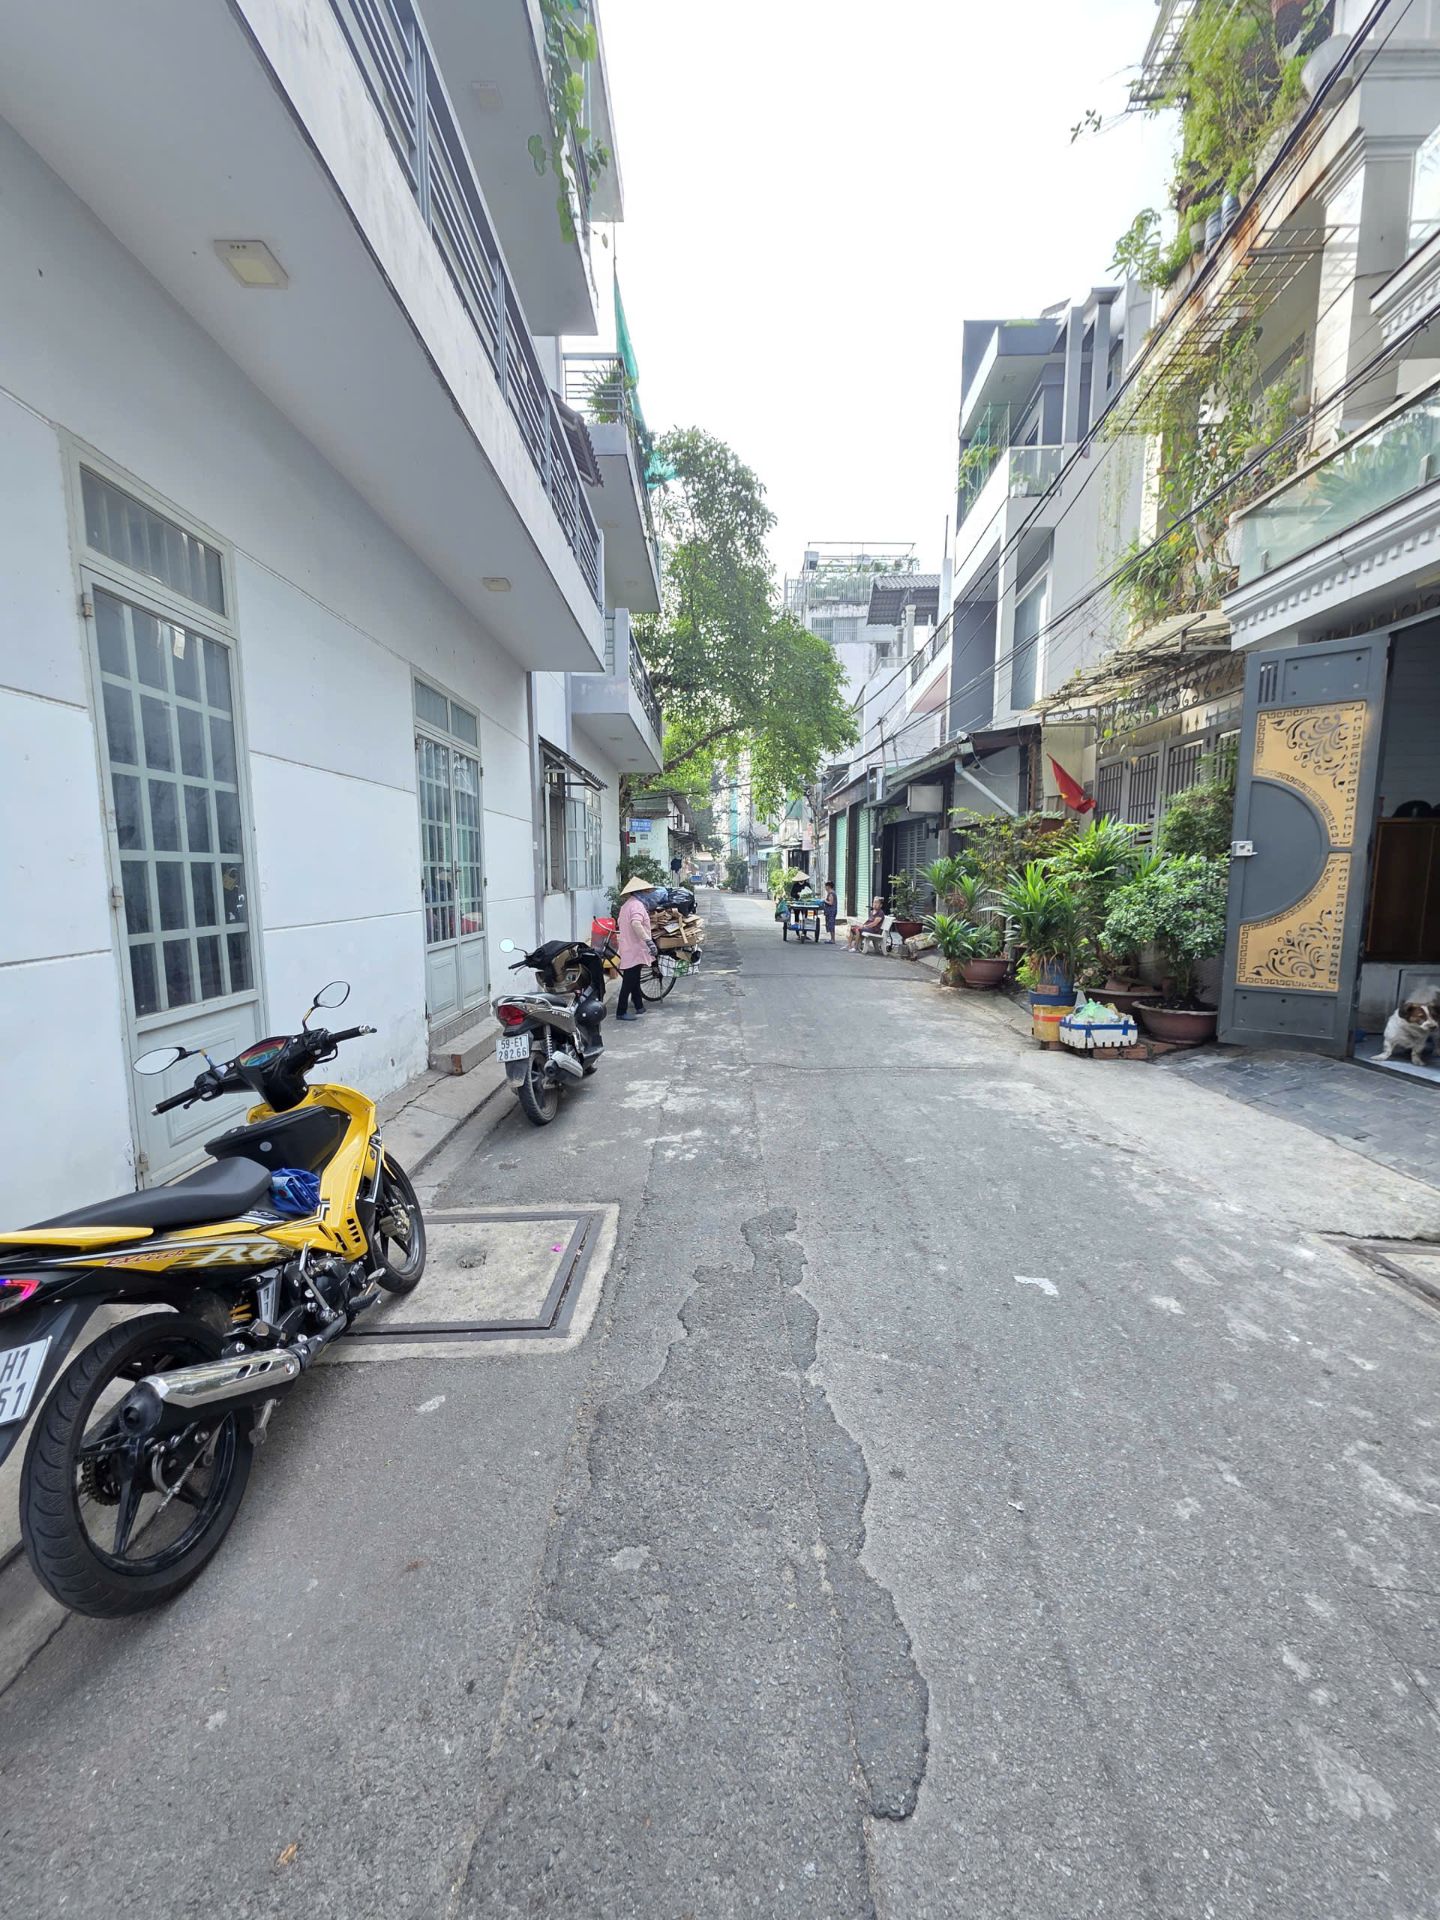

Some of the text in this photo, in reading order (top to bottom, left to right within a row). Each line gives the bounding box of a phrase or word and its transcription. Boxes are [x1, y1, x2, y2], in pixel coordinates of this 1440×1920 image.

[501, 1037, 523, 1050] 59-E1
[499, 1047, 527, 1061] 282.66
[0, 1348, 31, 1383] H1
